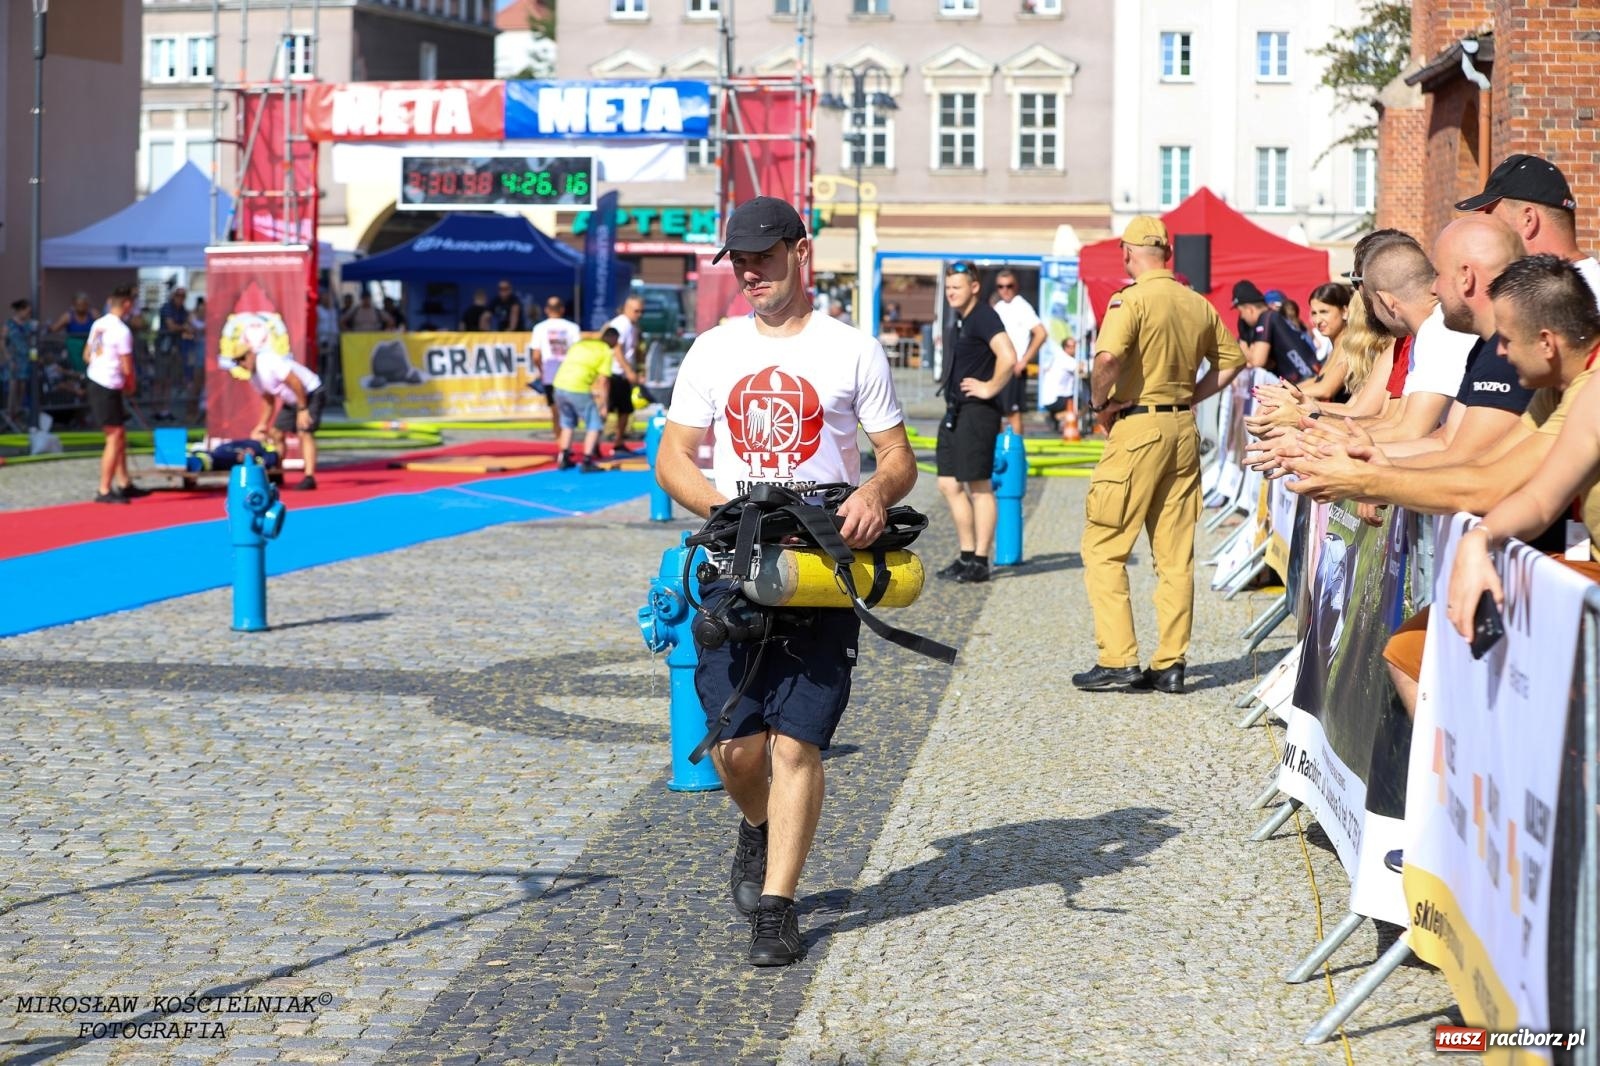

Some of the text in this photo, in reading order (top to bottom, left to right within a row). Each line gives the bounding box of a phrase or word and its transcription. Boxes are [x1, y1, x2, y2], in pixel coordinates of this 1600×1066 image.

[332, 87, 473, 135] META
[538, 87, 683, 133] META
[1473, 381, 1511, 393] BOZPO
